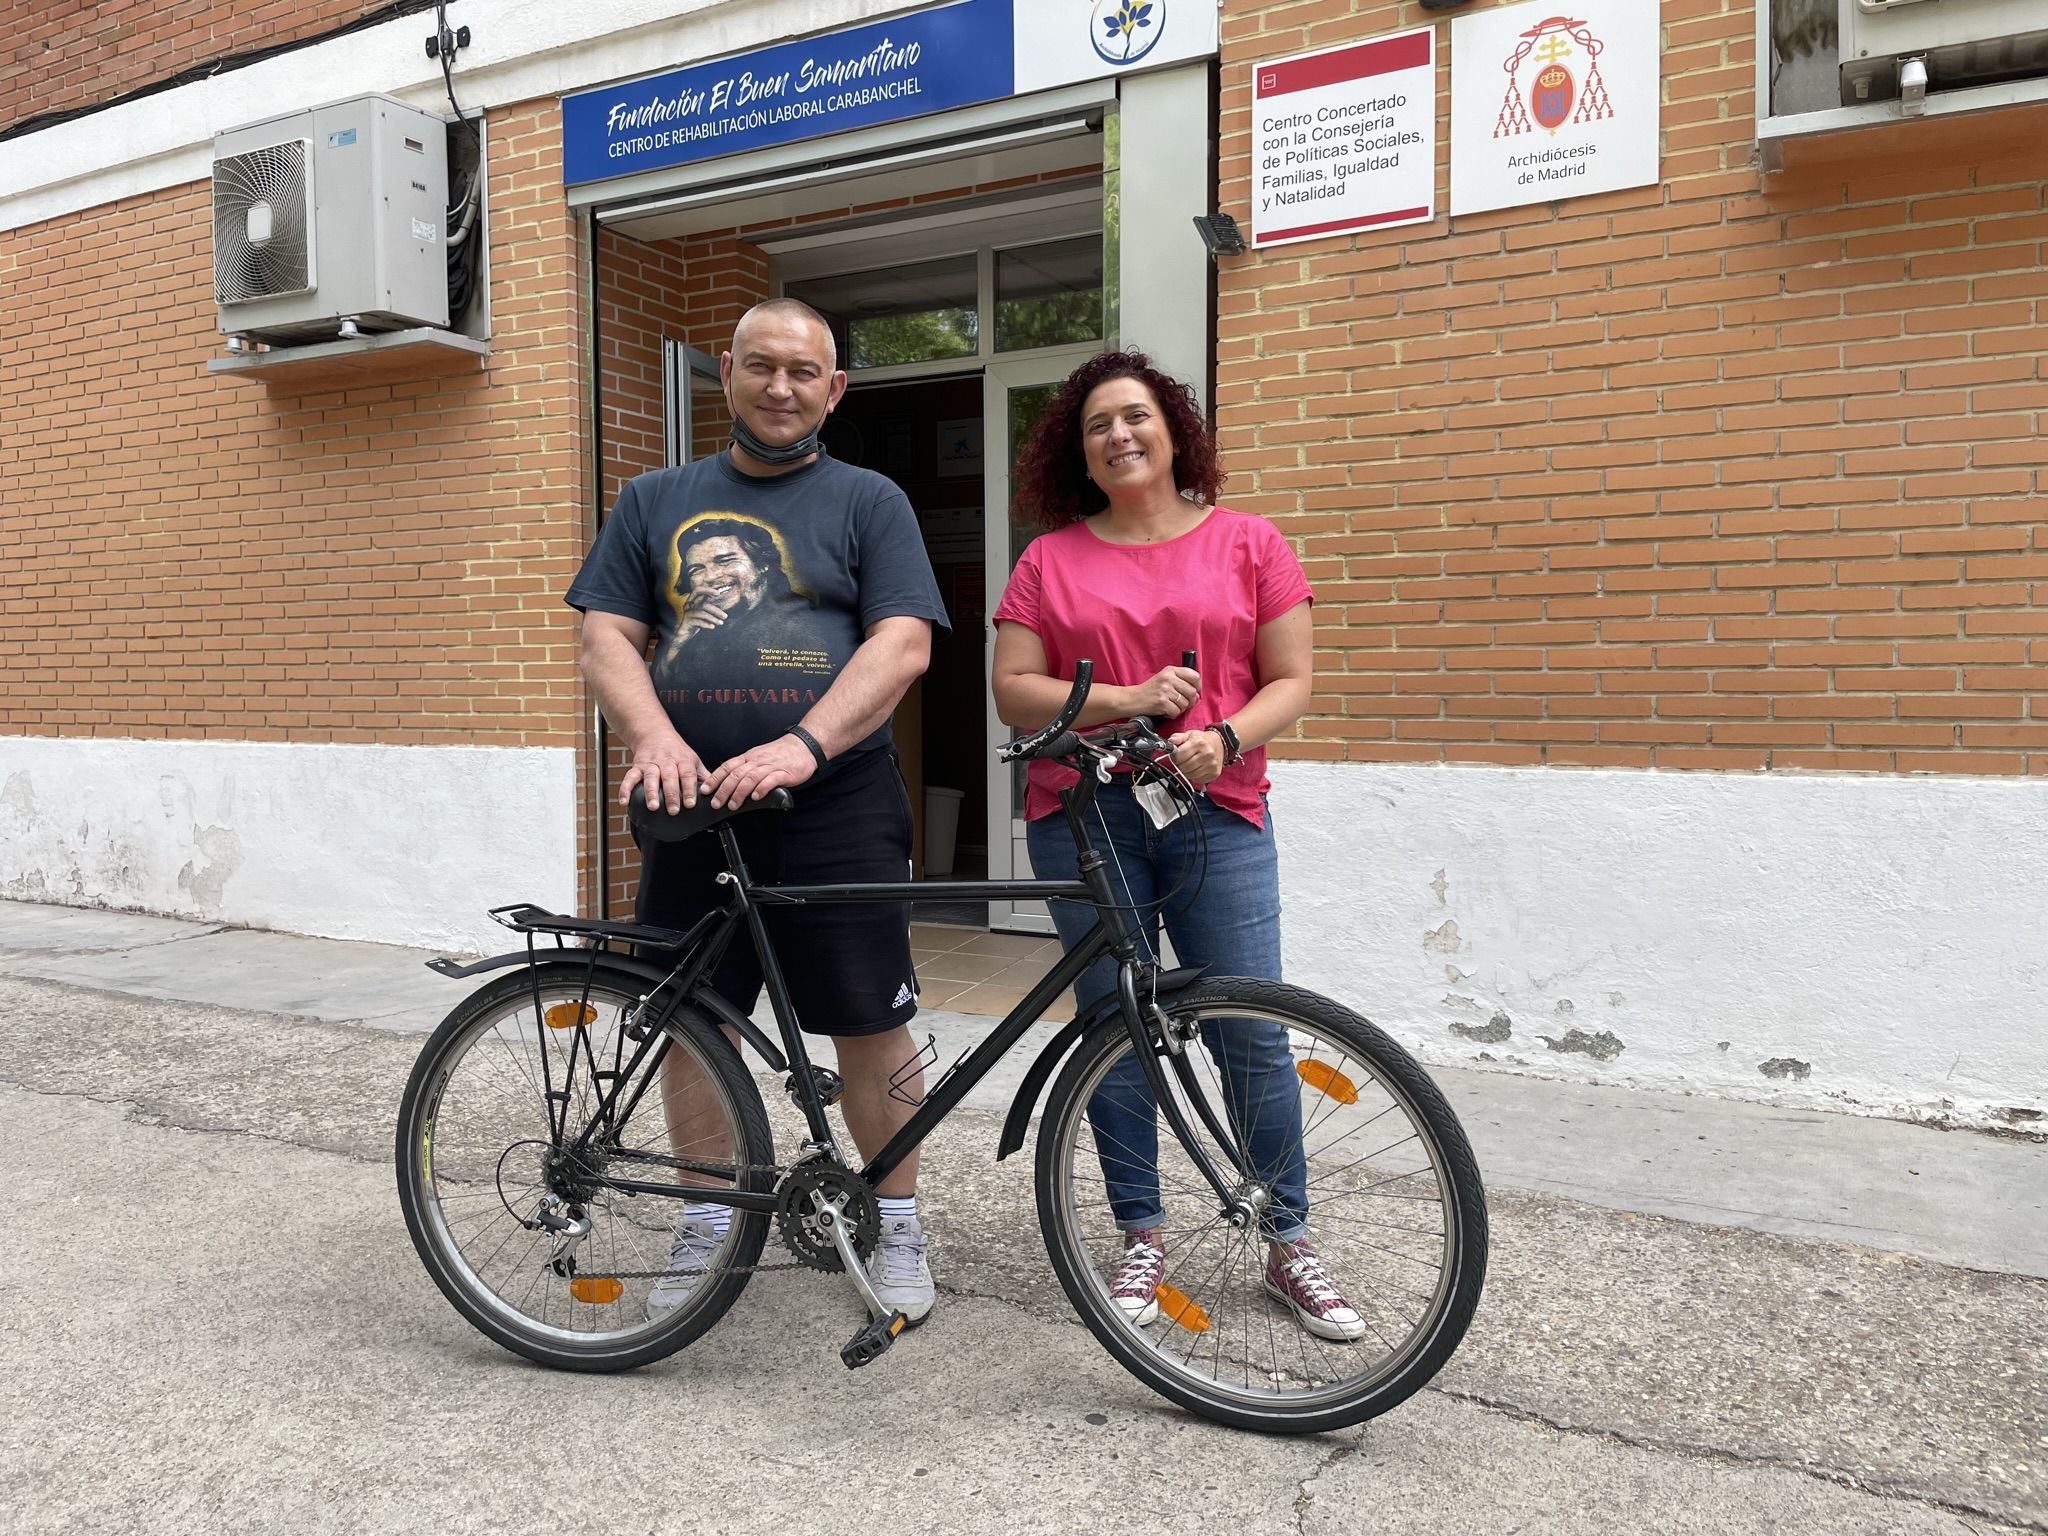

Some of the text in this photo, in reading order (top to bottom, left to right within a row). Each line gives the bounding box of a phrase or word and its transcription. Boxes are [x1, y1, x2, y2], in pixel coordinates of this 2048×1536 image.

[607, 38, 921, 137] Fundación El Buen Samaritano
[608, 77, 922, 158] CENTRO DE REHABILITACIÓN LABORAL CARABANCHEL
[1262, 93, 1407, 133] Centro Concertado
[1263, 114, 1395, 151] con la Consejería
[1262, 131, 1424, 170] de Políticas Sociales,
[1508, 143, 1597, 169] Archidiócesis
[1262, 152, 1400, 190] Familias, Igualdad
[1517, 162, 1586, 185] de Madrid
[1262, 181, 1345, 212] y Natalidad
[697, 688, 816, 704] GUEVARA
[891, 991, 912, 1009] adidas
[1182, 995, 1229, 1005] MARATHON
